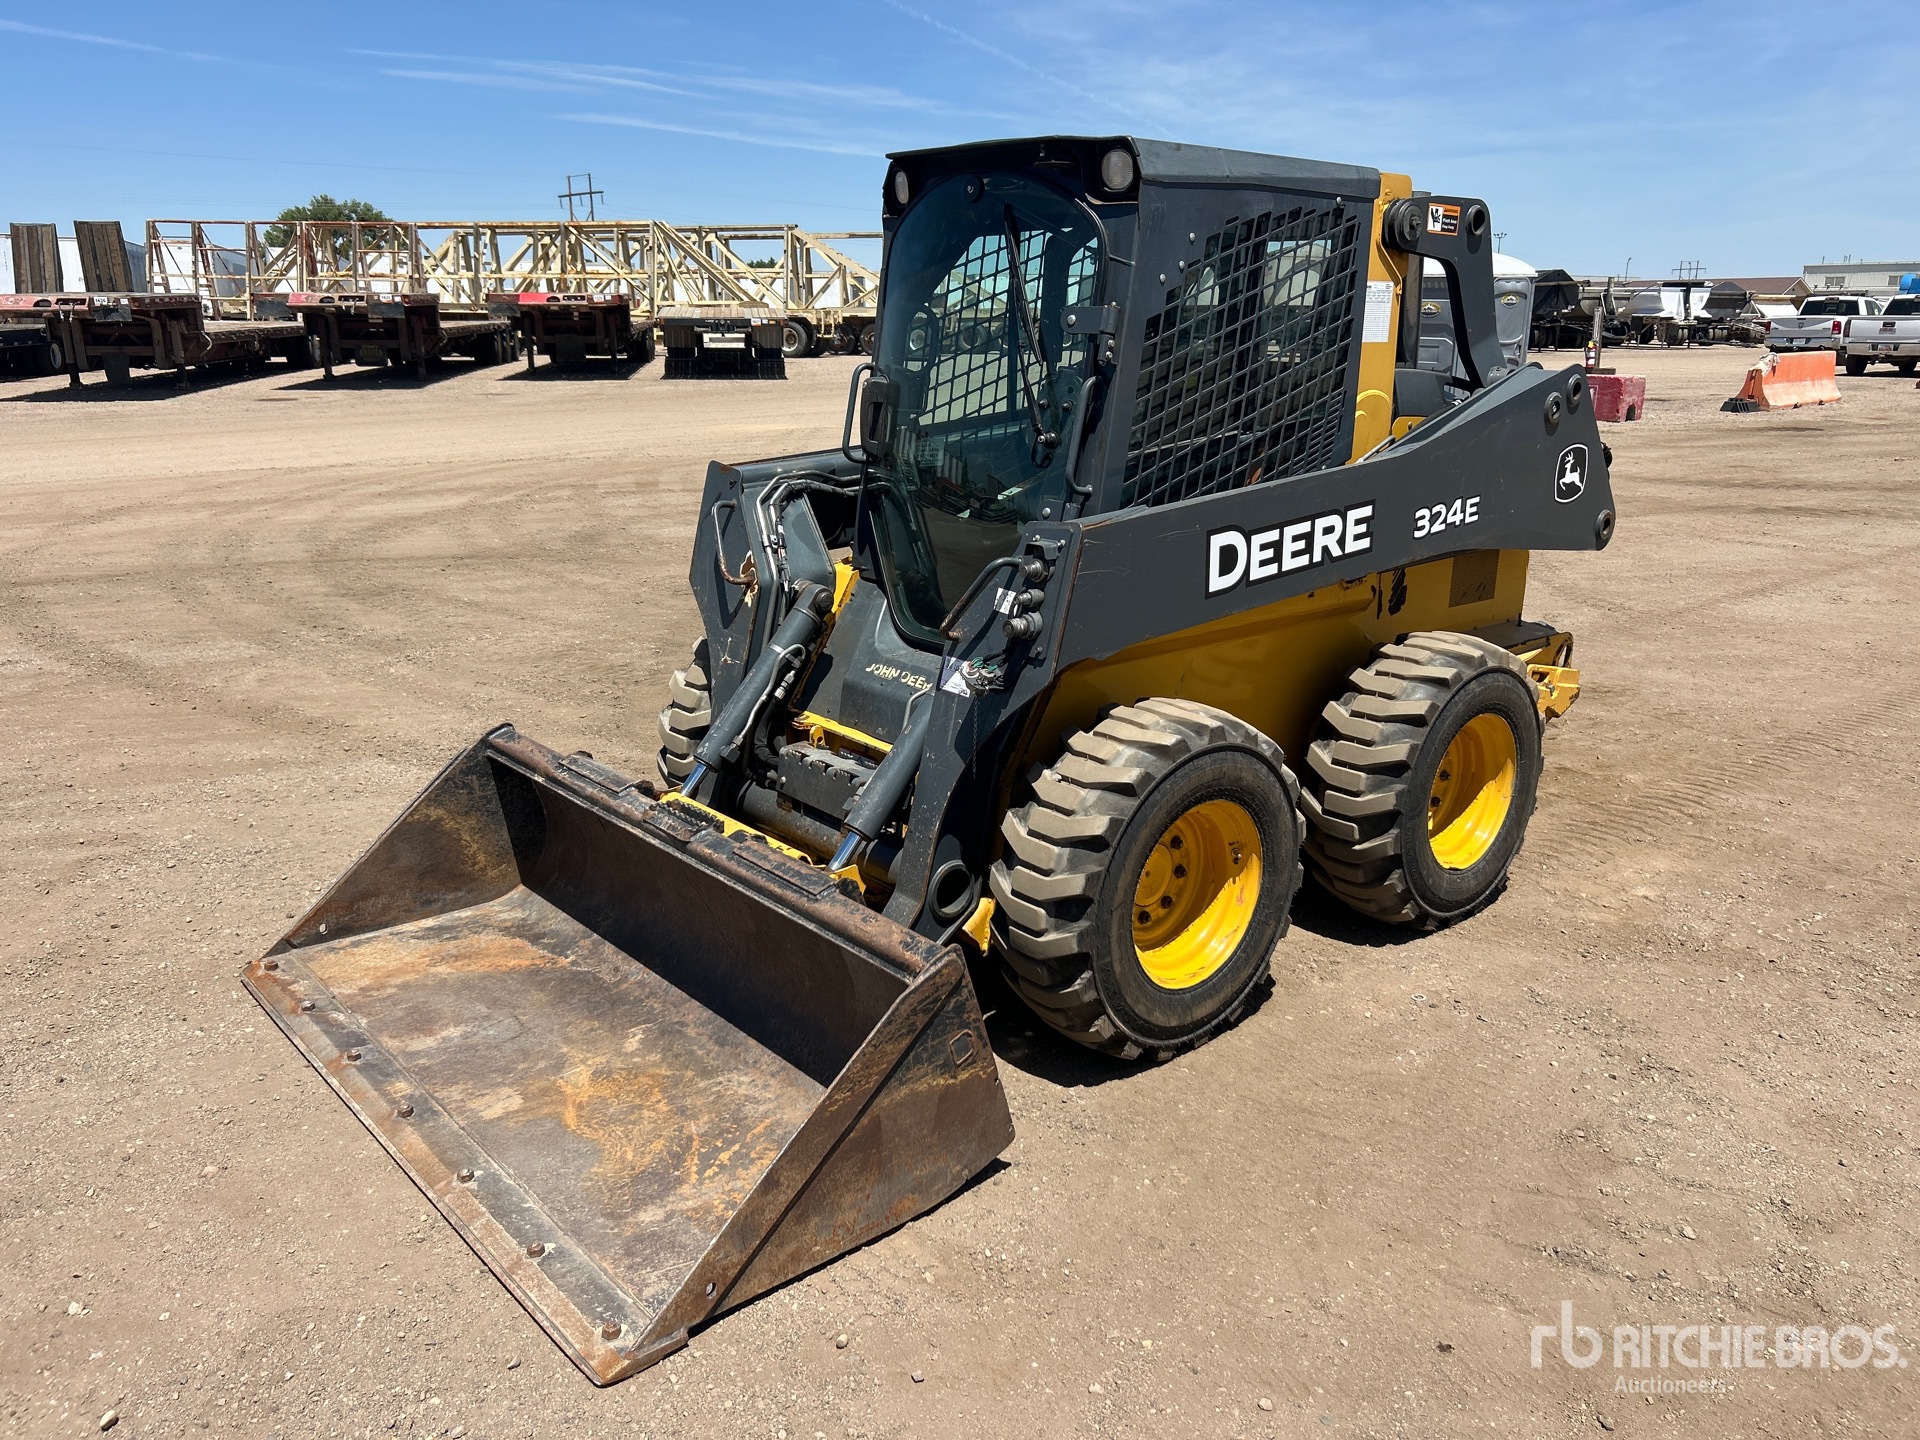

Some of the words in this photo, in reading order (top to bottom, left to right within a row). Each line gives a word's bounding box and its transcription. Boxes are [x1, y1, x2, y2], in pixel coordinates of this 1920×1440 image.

[1414, 496, 1480, 538] 324E
[1208, 504, 1373, 593] DEERE
[865, 663, 900, 680] JOHN
[900, 671, 933, 691] DEER
